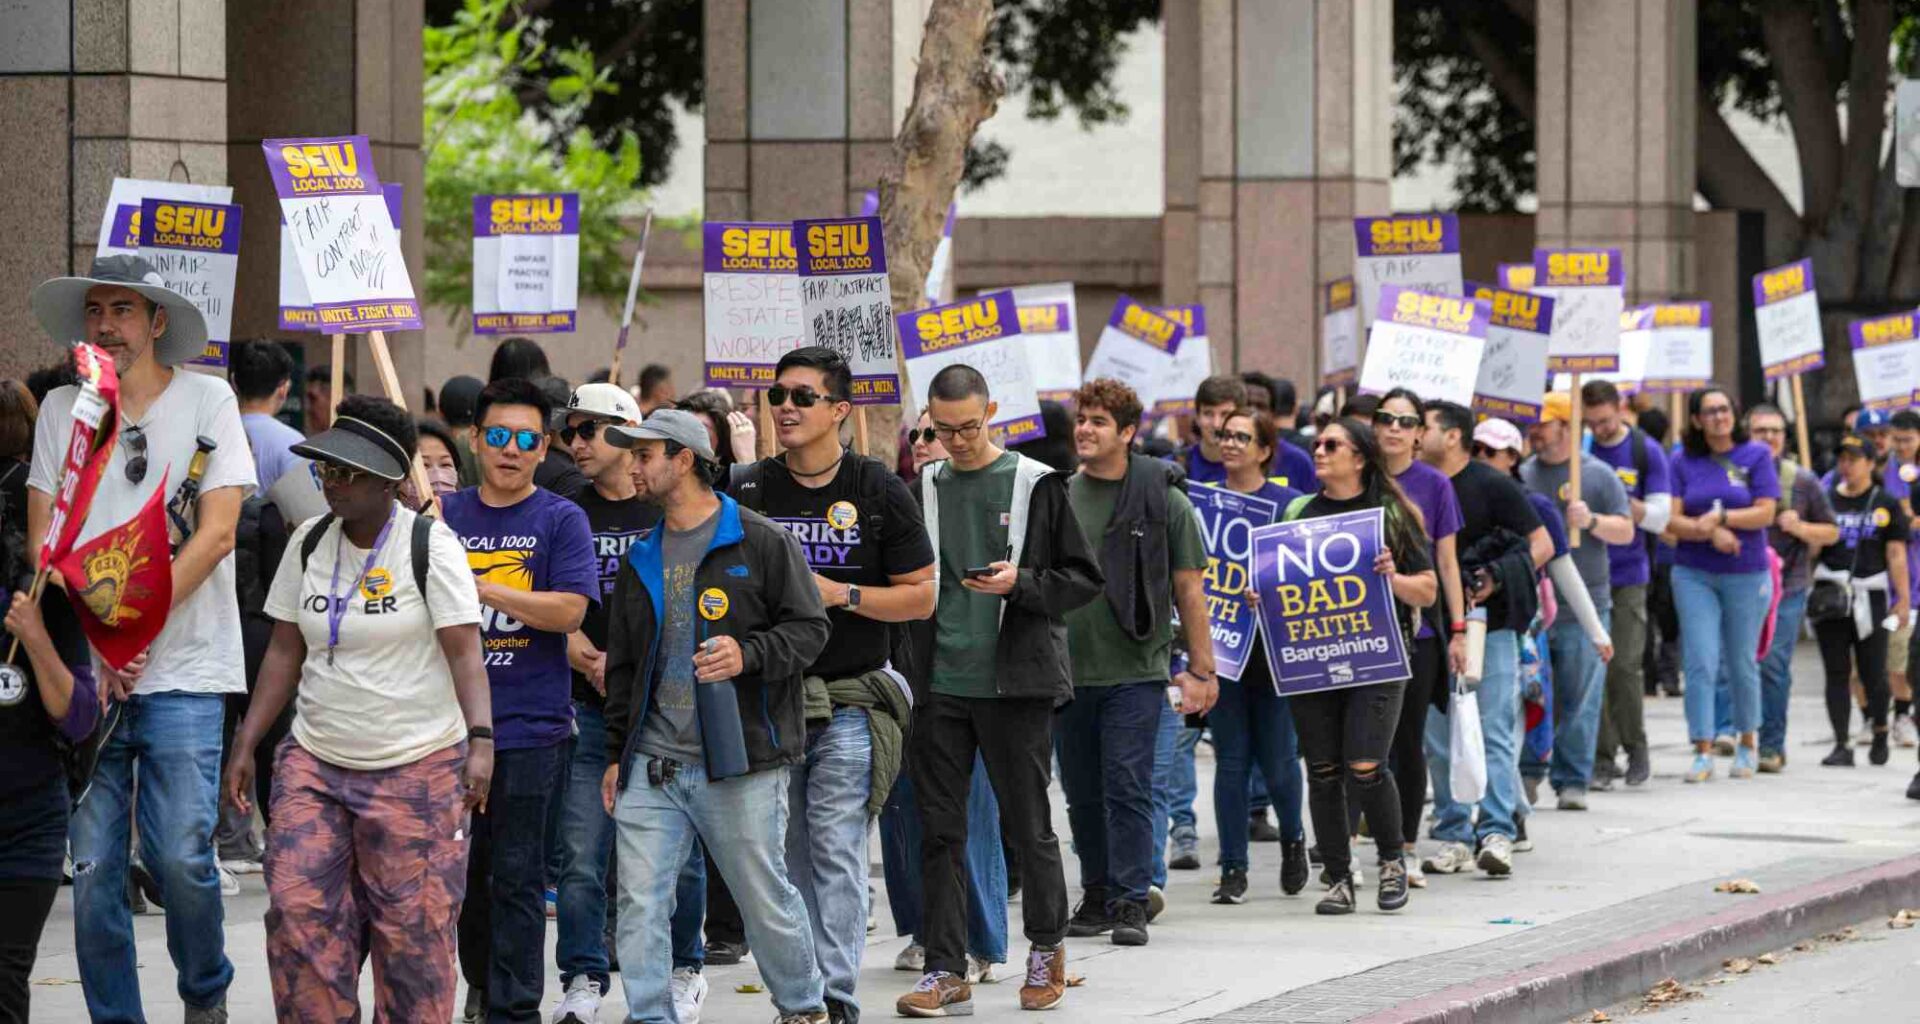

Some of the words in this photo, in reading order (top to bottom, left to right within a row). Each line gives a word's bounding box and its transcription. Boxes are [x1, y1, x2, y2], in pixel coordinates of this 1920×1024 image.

[282, 142, 358, 178] SEIU
[292, 177, 331, 192] LOCAL
[334, 176, 365, 191] 1000
[155, 204, 227, 238] SEIU
[490, 196, 563, 224] SEIU
[153, 233, 188, 247] LOCAL
[191, 235, 222, 249] 1000
[807, 224, 869, 257] SEIU
[1370, 217, 1443, 244] SEIU
[722, 257, 766, 270] LOCAL
[809, 258, 840, 271] LOCAL
[842, 256, 872, 270] 1000
[1548, 252, 1609, 276] SEIU
[707, 274, 798, 303] RESPE
[802, 278, 829, 305] FAIR
[319, 306, 358, 324] UNITE.
[358, 304, 391, 322] FIGHT.
[916, 298, 999, 341] SEIU
[1396, 291, 1474, 323] SEIU
[921, 335, 965, 353] LOCAL
[967, 325, 1003, 342] 1000
[710, 367, 749, 380] UNITE.
[500, 535, 537, 549] 1000
[801, 545, 852, 565] ADY
[1278, 532, 1361, 583] NO
[1202, 557, 1248, 595] AD
[1277, 574, 1367, 618] BAD
[1286, 610, 1373, 643] FAITH
[485, 636, 530, 650] ogether
[1280, 634, 1389, 664] Bargaining
